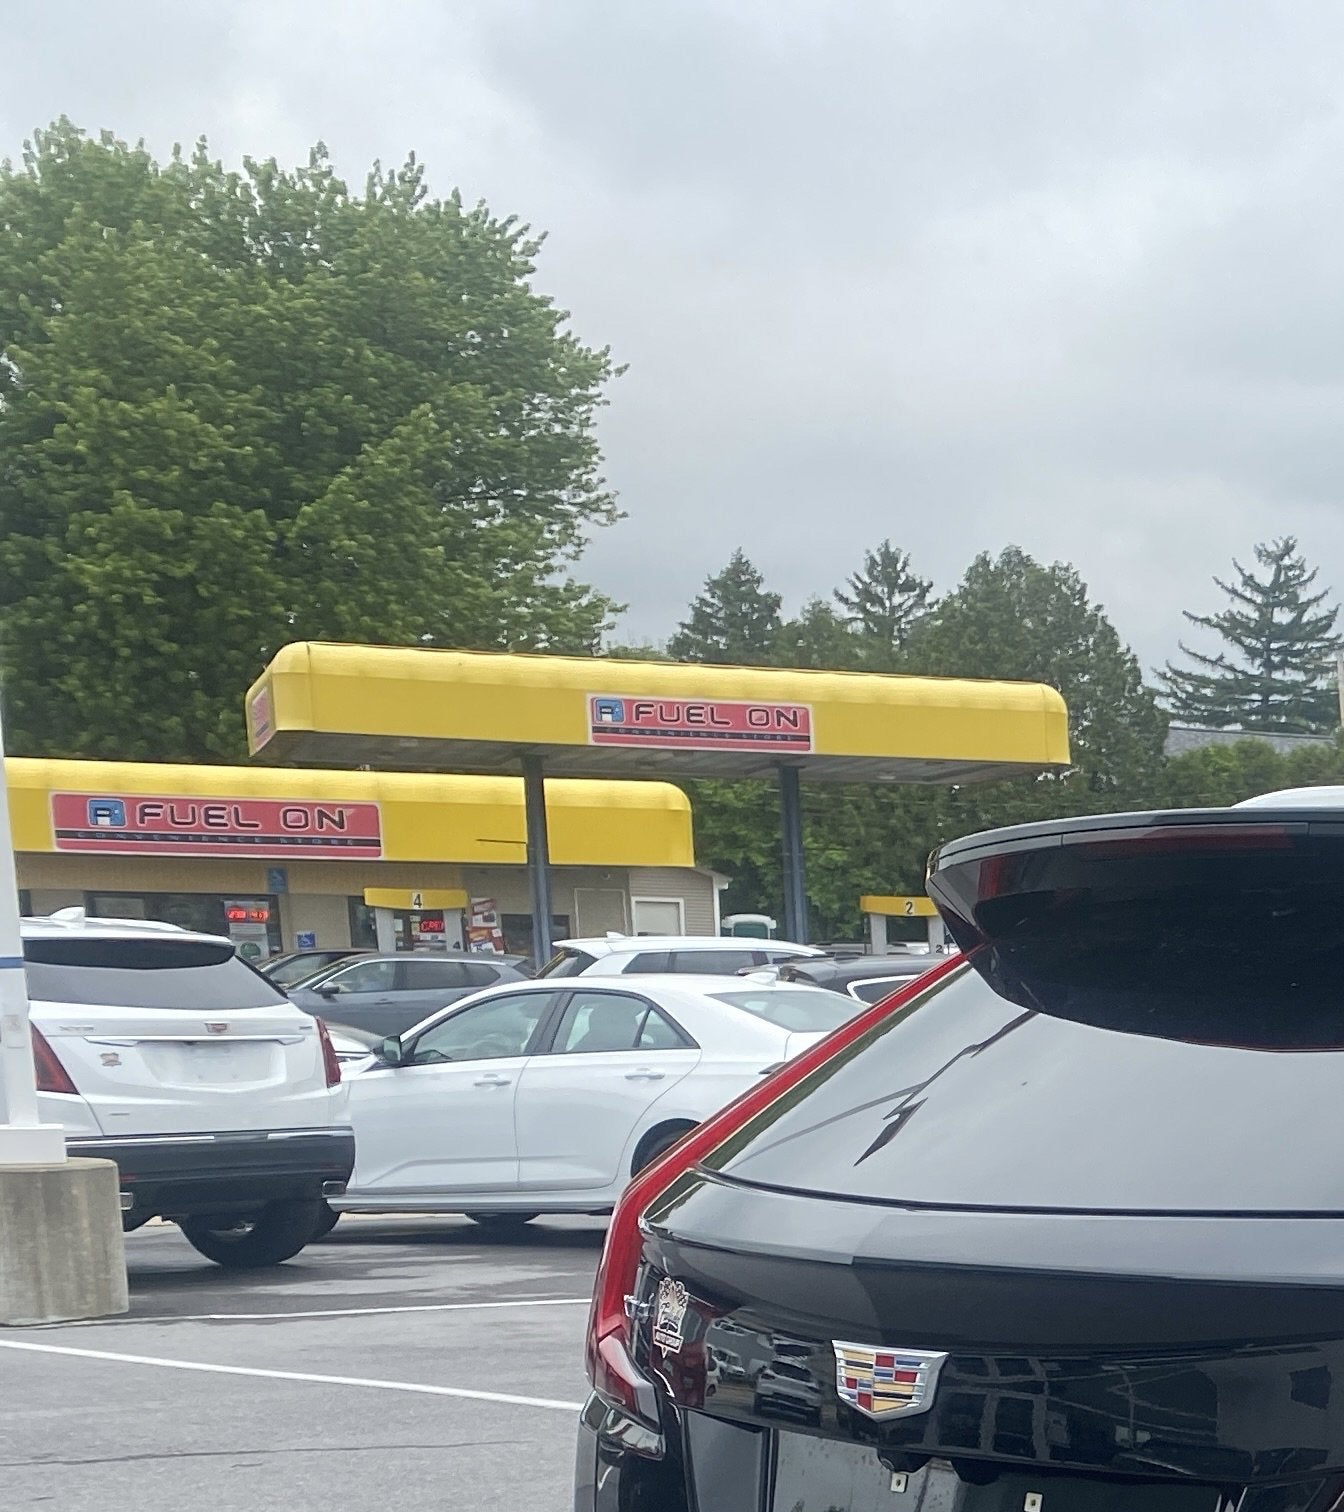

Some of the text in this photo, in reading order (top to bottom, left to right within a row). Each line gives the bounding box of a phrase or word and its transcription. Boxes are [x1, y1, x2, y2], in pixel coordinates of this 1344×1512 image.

[634, 703, 799, 728] FUEL ON
[137, 803, 346, 831] FUEL ON
[413, 894, 422, 908] 4
